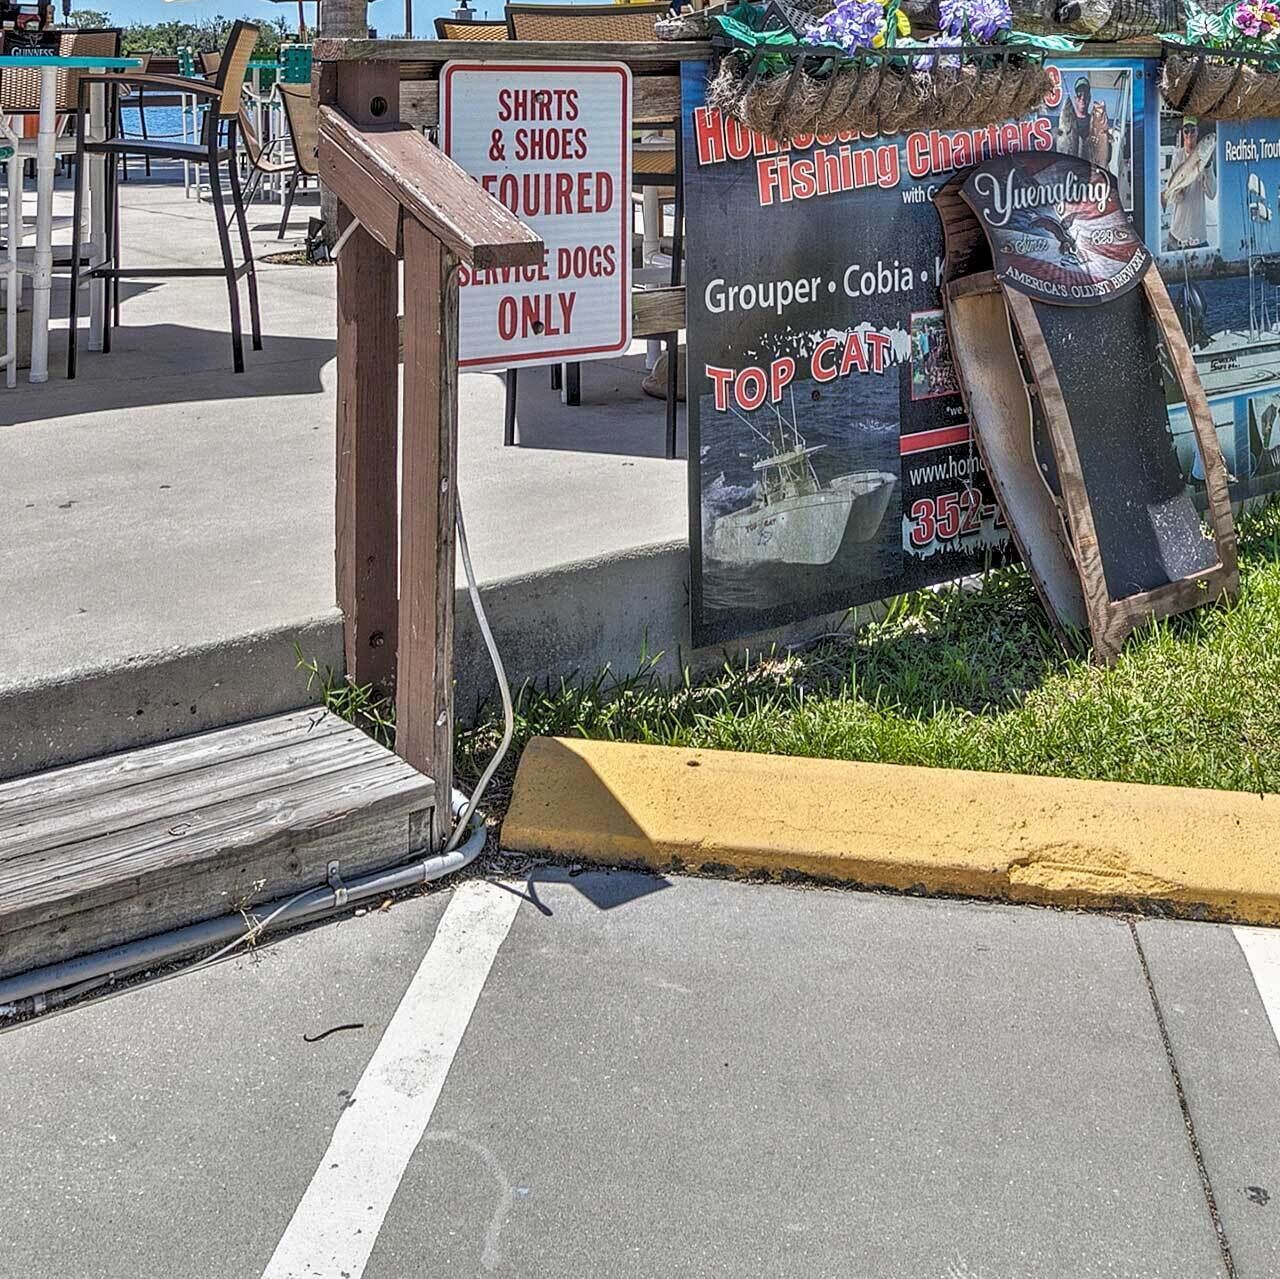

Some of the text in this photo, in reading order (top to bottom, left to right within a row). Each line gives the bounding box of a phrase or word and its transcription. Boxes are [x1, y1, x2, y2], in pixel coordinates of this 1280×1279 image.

[11, 46, 54, 56] GUINNESS
[498, 88, 580, 122] SHIRTS
[488, 127, 588, 161] & SHOES
[756, 143, 901, 206] Fishing
[905, 117, 1054, 178] Charters
[1225, 138, 1259, 162] Redfish,
[471, 171, 614, 217] EQUIRED
[902, 187, 927, 203] with
[557, 244, 616, 279] DOGS
[1006, 248, 1147, 298] AMERICA'S OLDEST BREWERY
[704, 275, 821, 315] Grouper
[843, 260, 914, 298] Cobia
[498, 291, 577, 341] ONLY
[705, 330, 893, 412] TOP CAT
